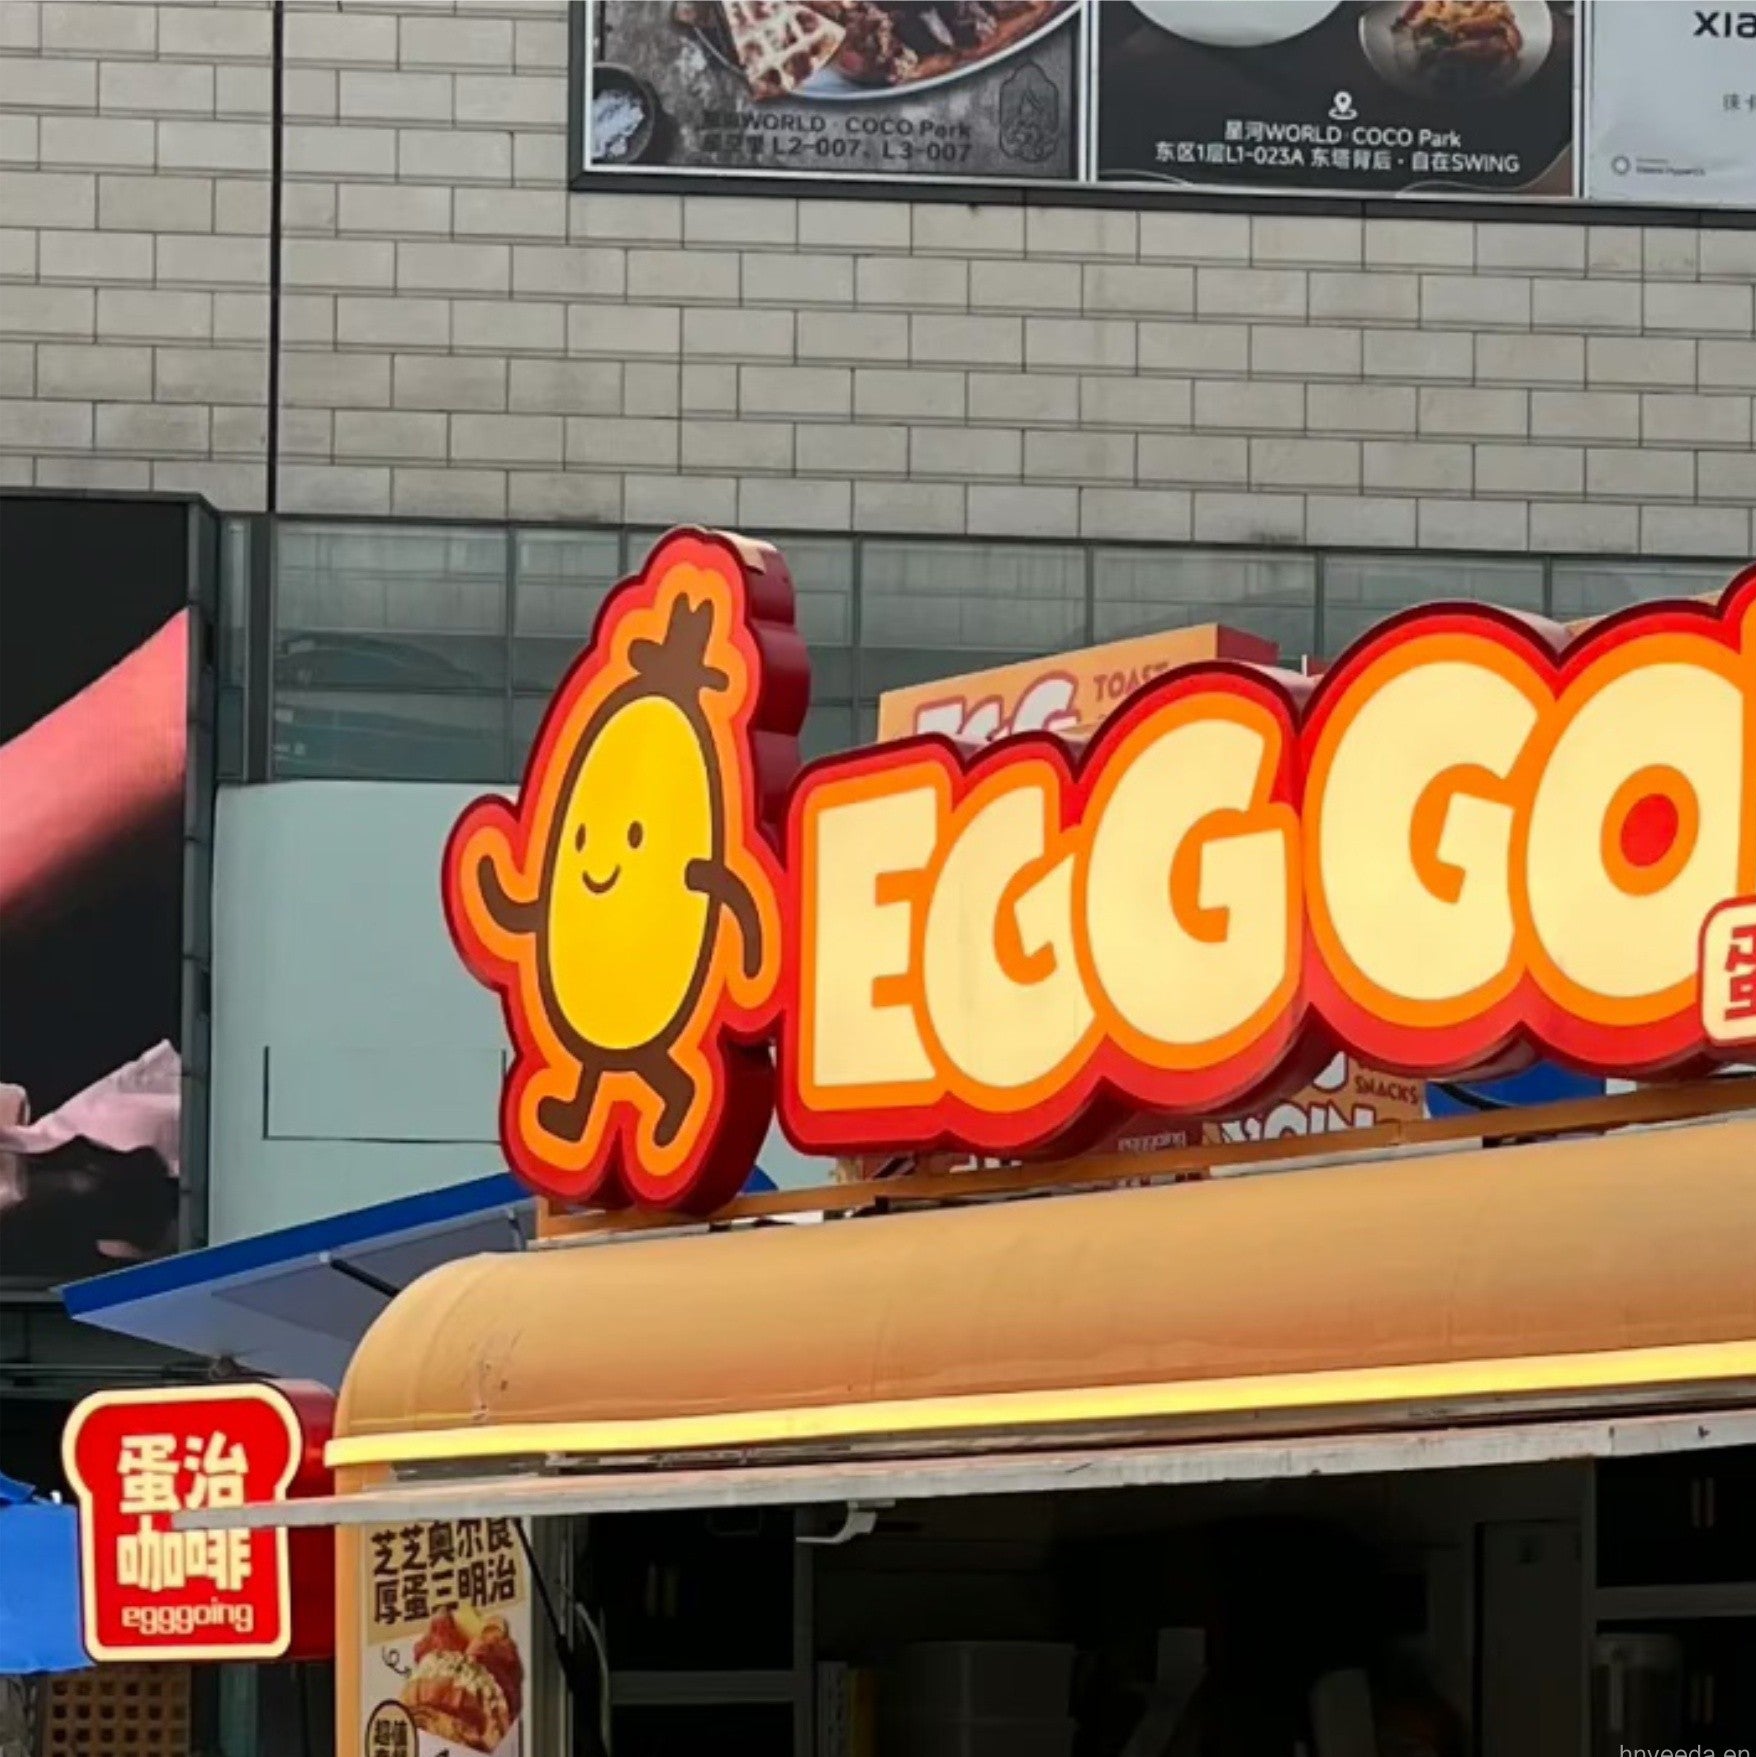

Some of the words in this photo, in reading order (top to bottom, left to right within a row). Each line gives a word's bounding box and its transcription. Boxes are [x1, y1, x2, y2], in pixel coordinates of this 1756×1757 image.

[845, 116, 913, 137] COCO
[919, 118, 971, 140] Park
[1352, 126, 1413, 147] COCO
[1418, 128, 1461, 148] Park
[117, 1430, 249, 1513] 蛋治
[117, 1514, 252, 1593] 咖啡
[122, 1596, 254, 1635] egggoing
[374, 1554, 516, 1625] 厚蛋三明治
